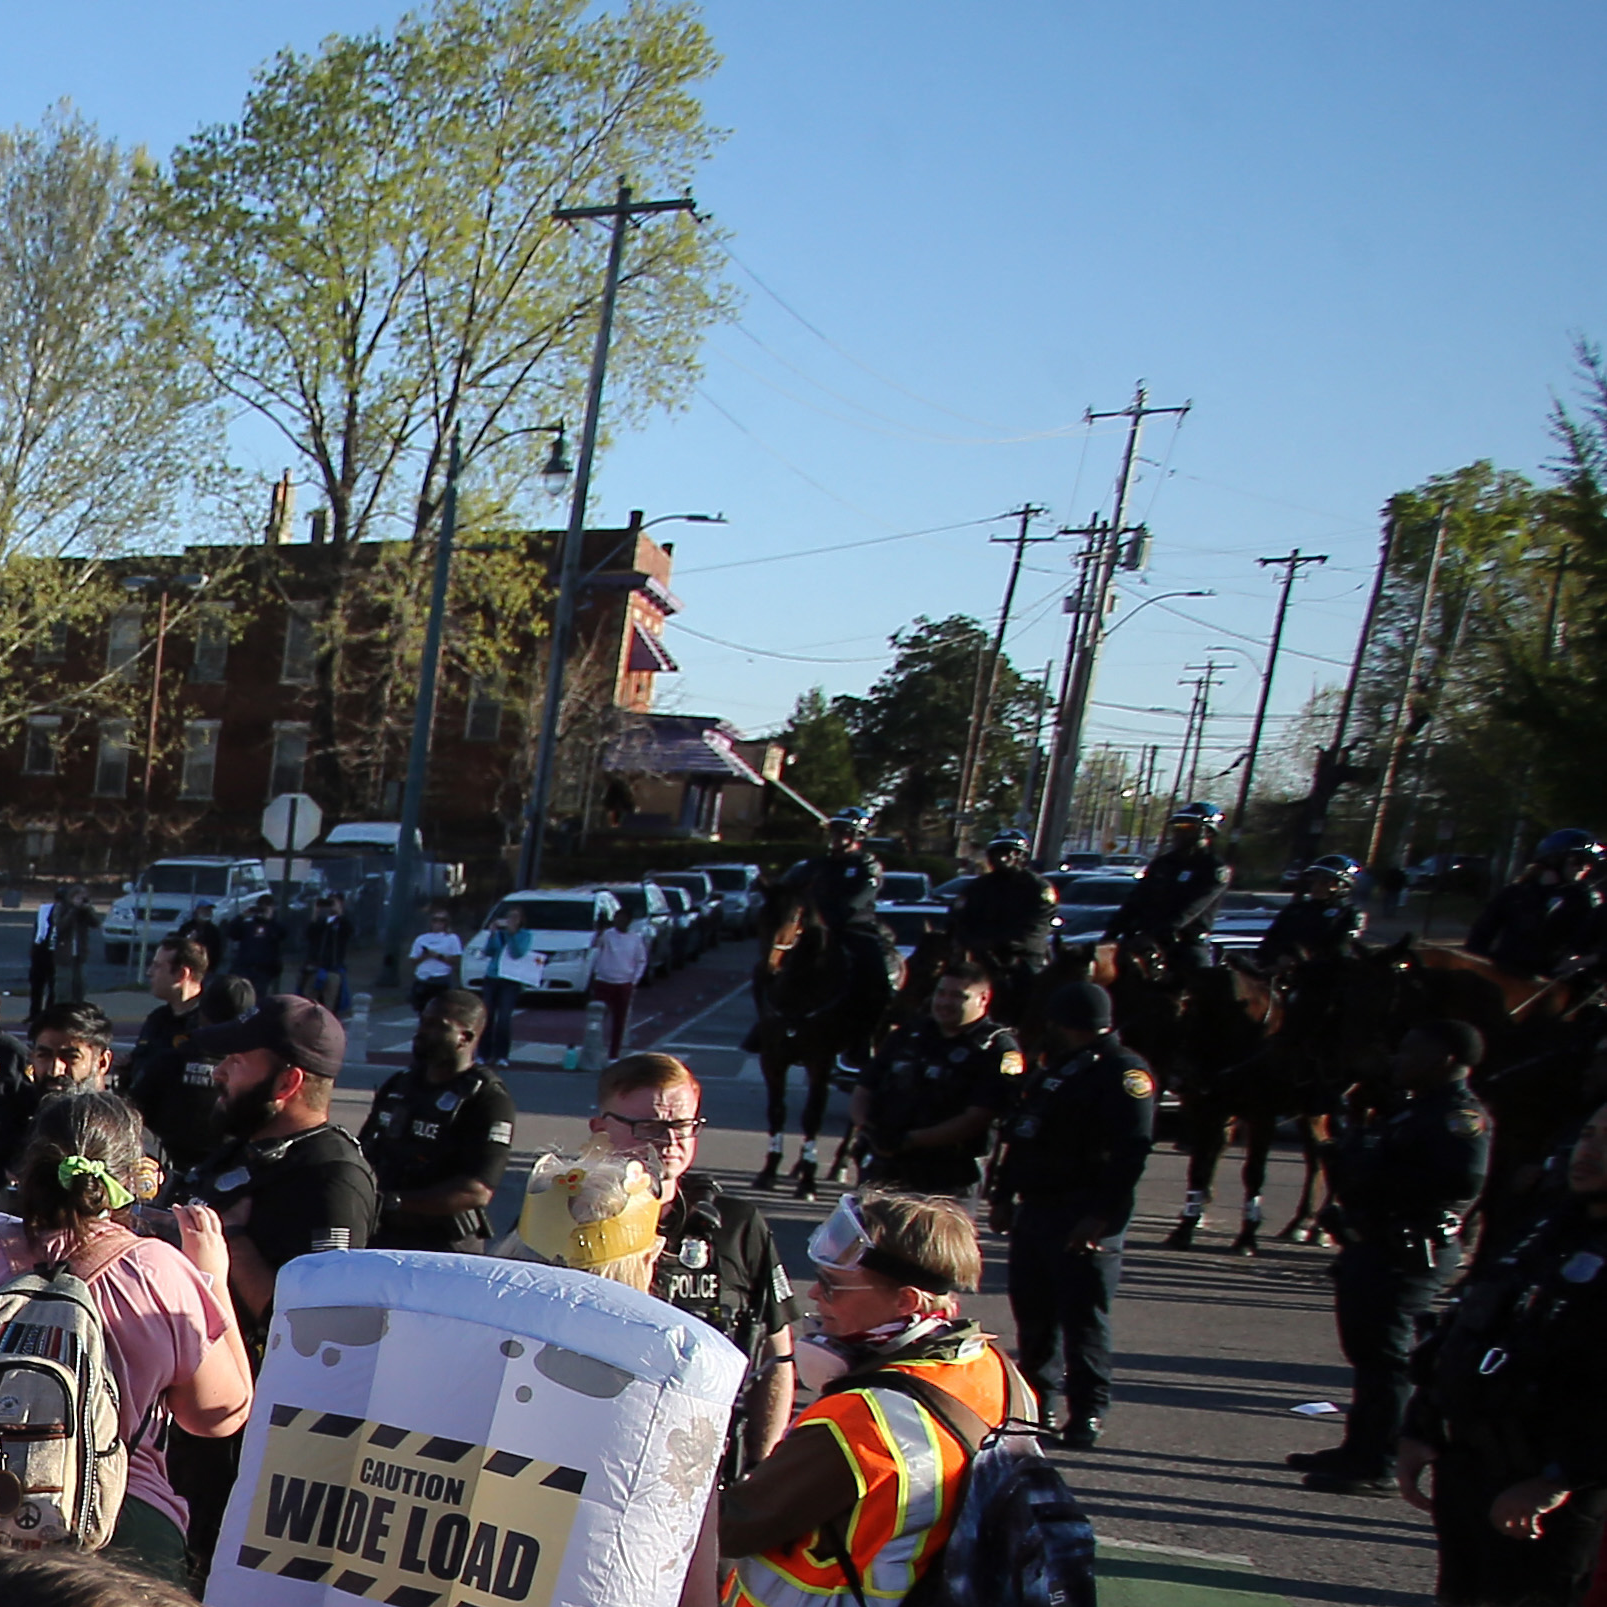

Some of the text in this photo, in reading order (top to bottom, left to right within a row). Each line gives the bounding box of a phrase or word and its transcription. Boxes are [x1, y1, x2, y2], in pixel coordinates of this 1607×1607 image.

[668, 1273, 719, 1304] POLICE
[359, 1457, 466, 1506] CAUTION
[264, 1473, 541, 1602] WIDE LOAD
